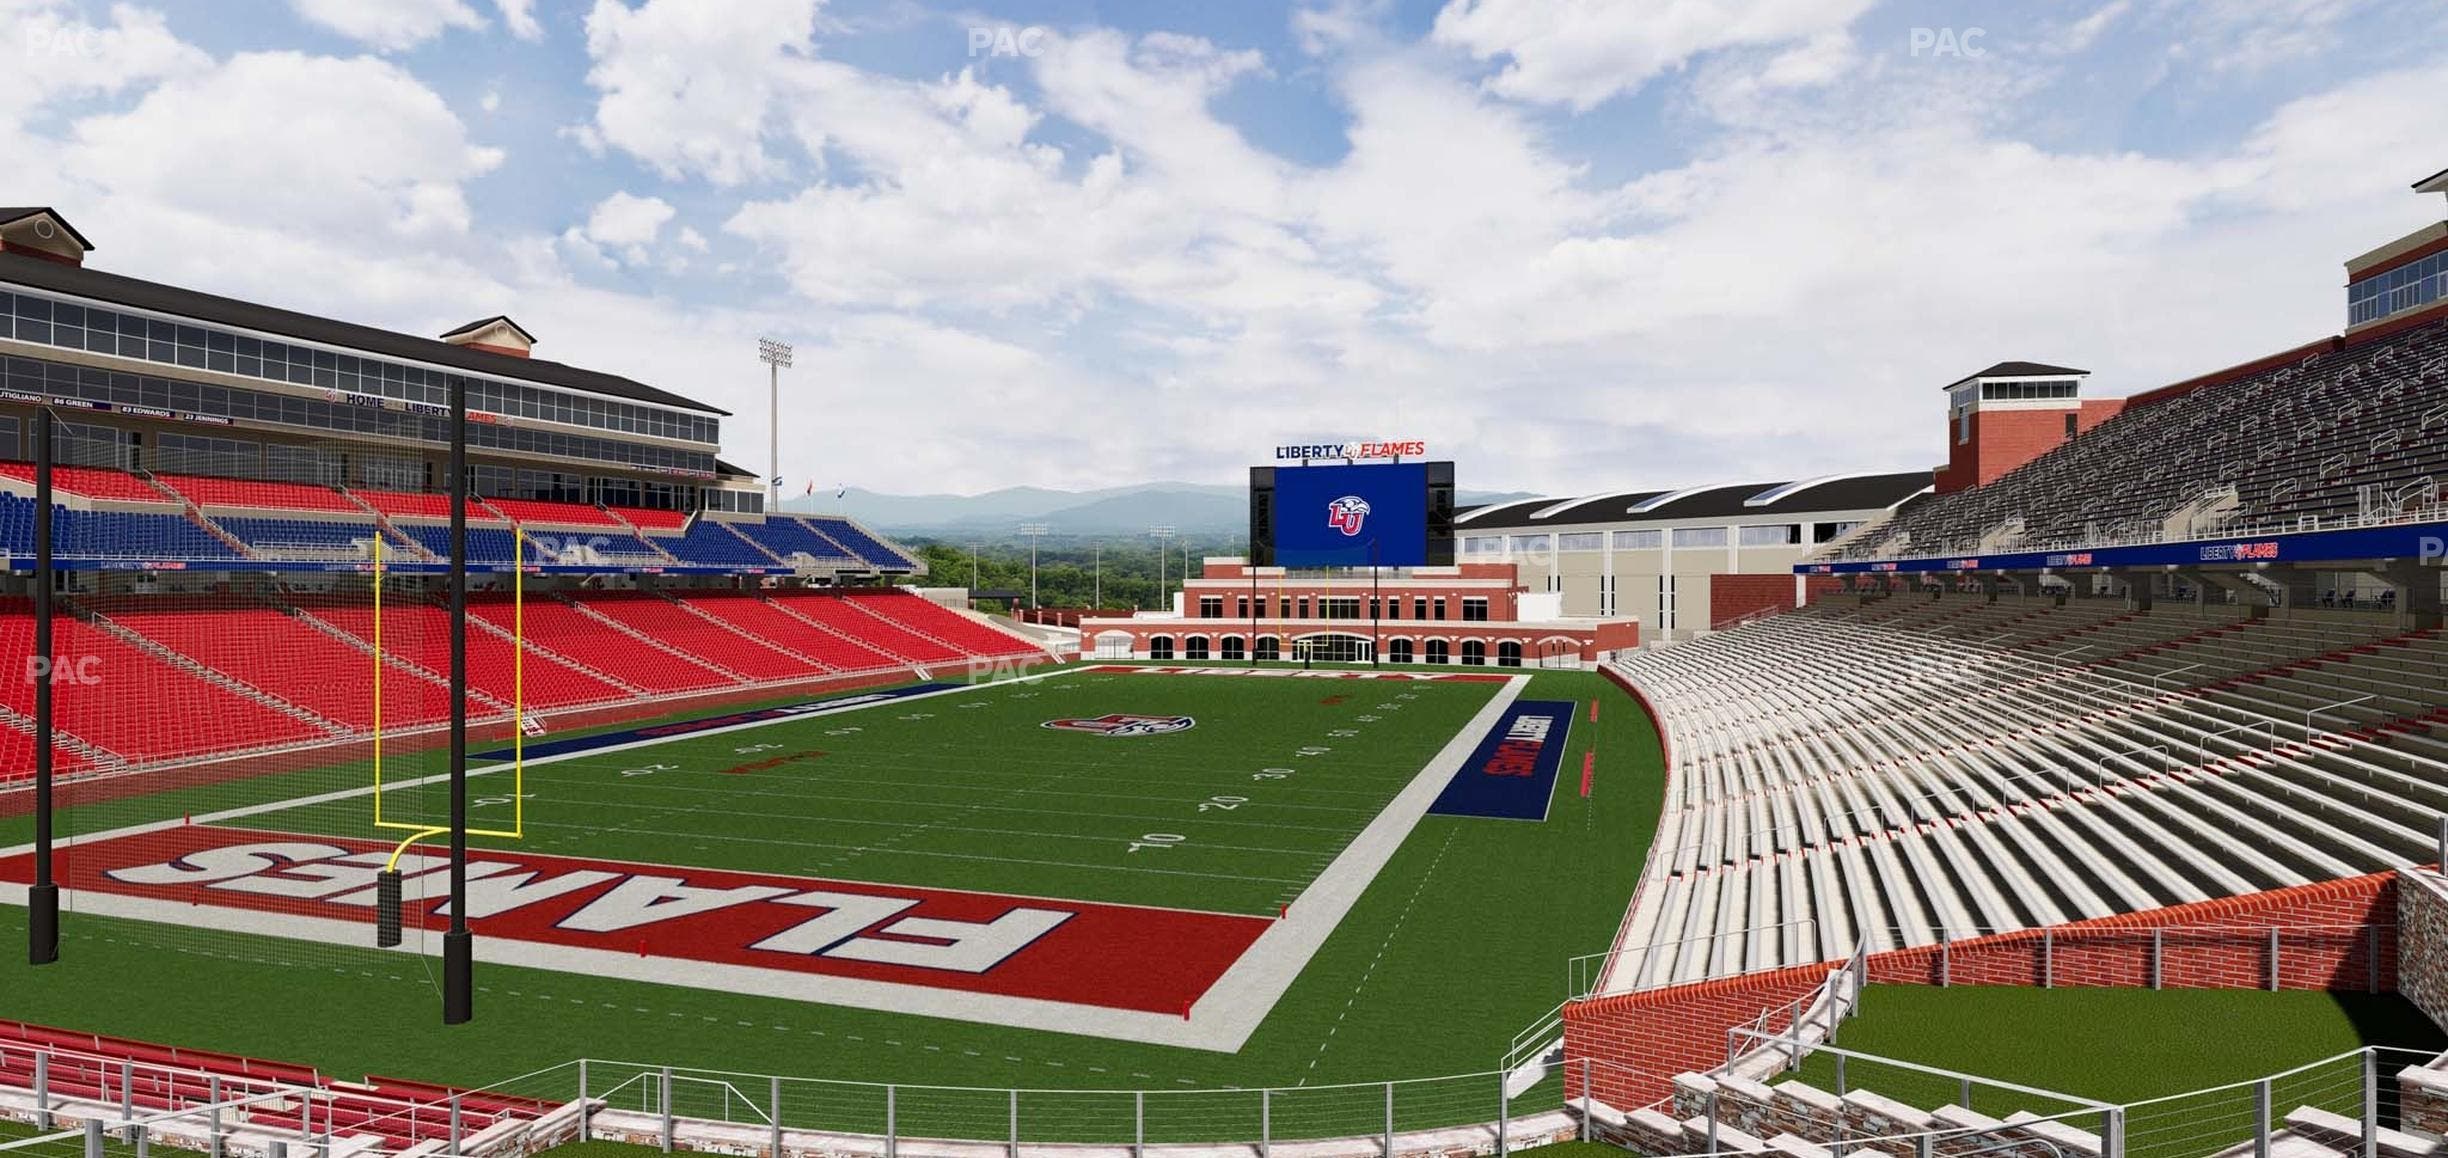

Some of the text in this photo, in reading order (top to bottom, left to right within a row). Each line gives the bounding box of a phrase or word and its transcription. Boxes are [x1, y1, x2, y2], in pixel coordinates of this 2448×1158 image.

[345, 394, 385, 408] HOME
[467, 411, 497, 423] AMES
[1276, 445, 1345, 459] LIBERTY
[1360, 441, 1425, 456] FLAMES
[101, 842, 1079, 974] FLAMES
